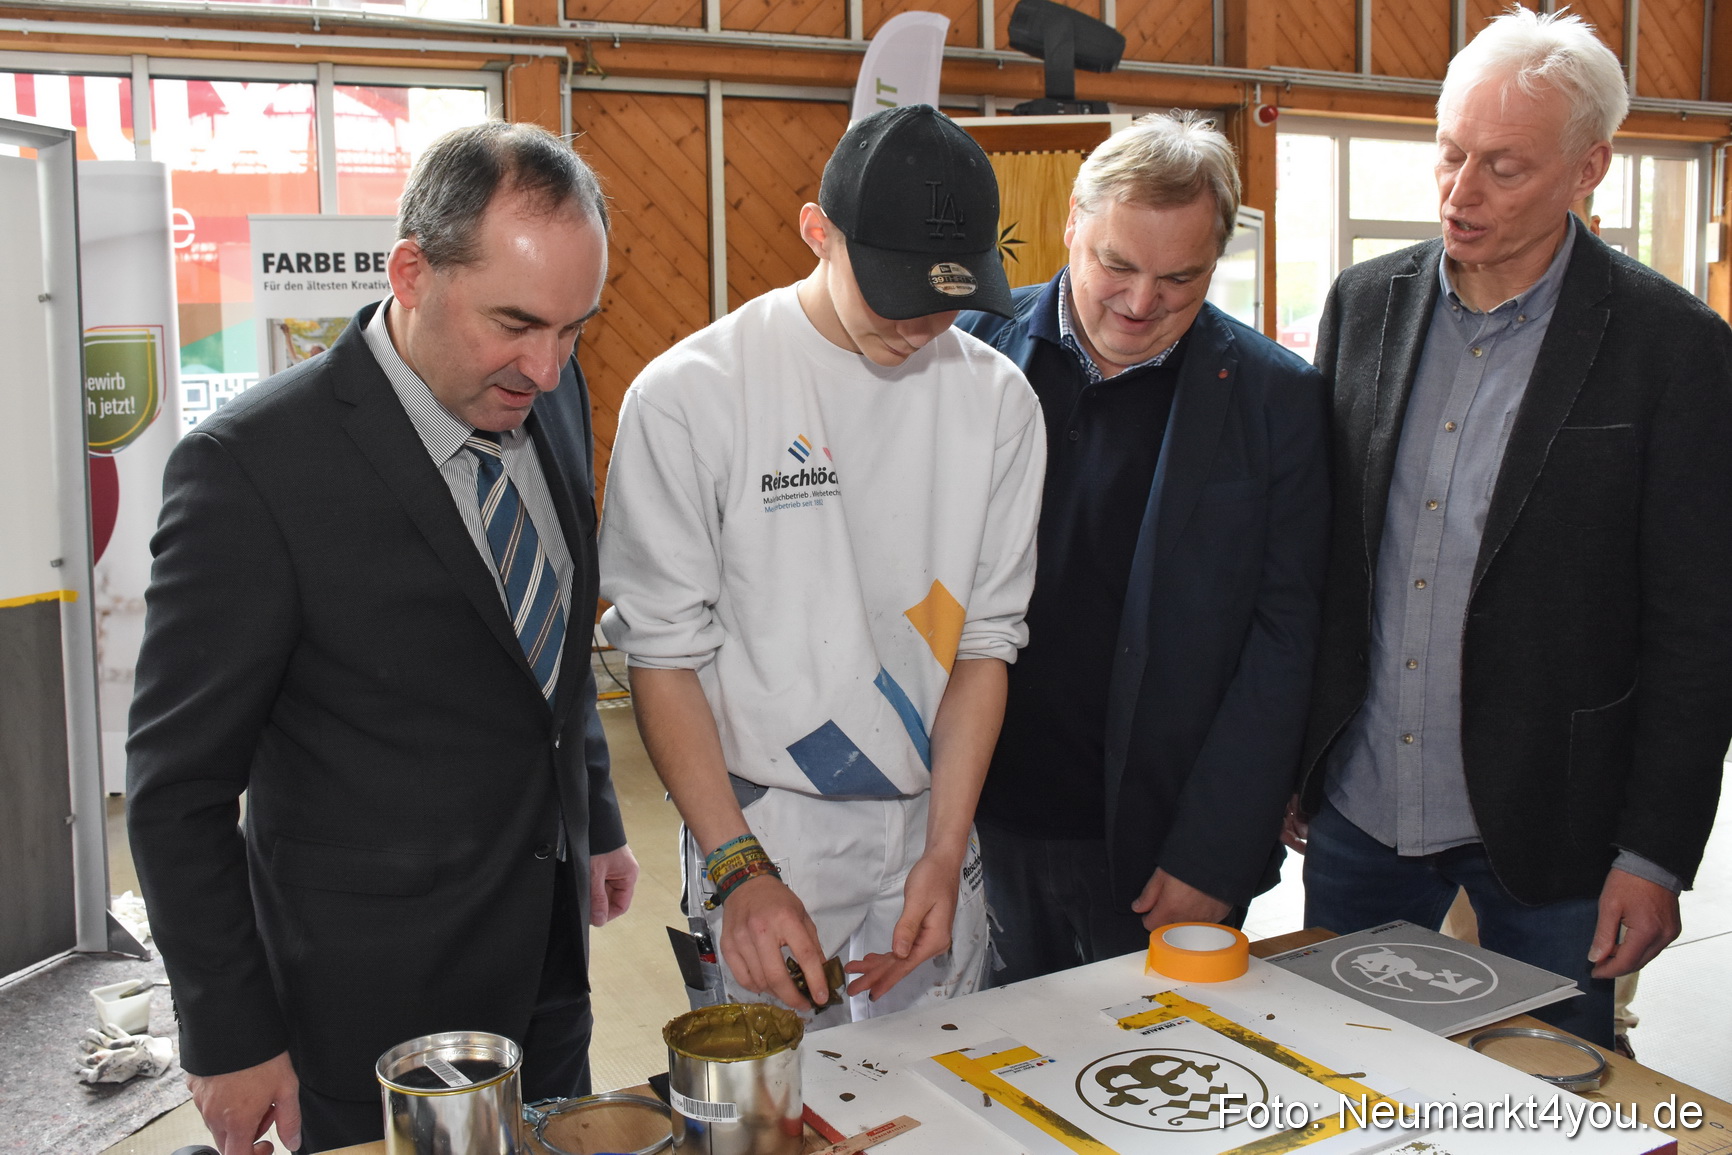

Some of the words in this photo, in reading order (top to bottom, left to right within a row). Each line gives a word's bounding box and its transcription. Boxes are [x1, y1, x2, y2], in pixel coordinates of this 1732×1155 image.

[925, 180, 965, 237] LA
[262, 252, 346, 273] FARBE
[354, 251, 391, 273] BE
[263, 280, 281, 291] Für
[284, 280, 303, 291] den
[306, 279, 348, 291] ältesten
[85, 372, 126, 391] ewirb
[99, 396, 136, 419] jetzt!
